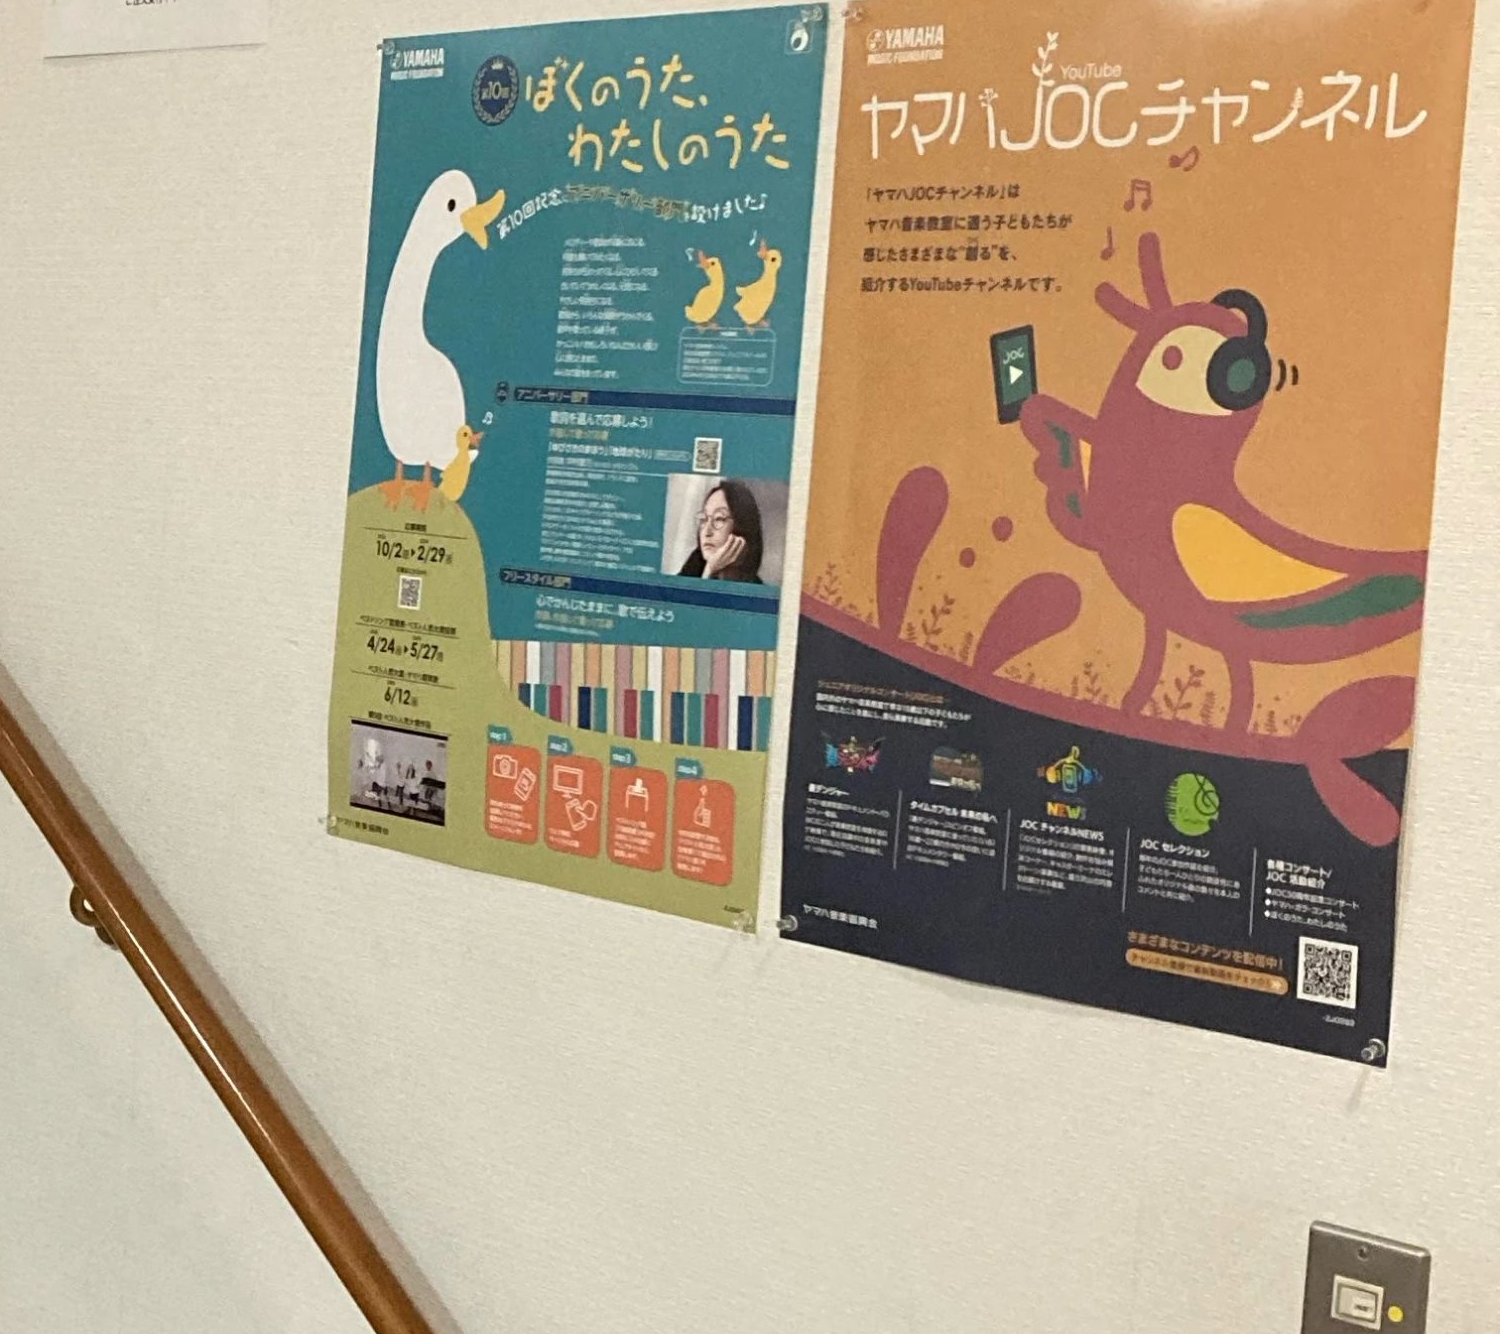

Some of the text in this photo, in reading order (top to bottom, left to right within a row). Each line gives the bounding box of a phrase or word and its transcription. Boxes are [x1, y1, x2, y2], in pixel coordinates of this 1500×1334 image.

[885, 25, 944, 49] YAMAHA
[403, 48, 444, 68] YAMAHA
[1061, 63, 1122, 80] YouTube
[568, 113, 790, 173] わたしのうた
[867, 184, 1020, 202] 「ヤマハJOCチャンネル」は
[866, 214, 1073, 233] ヤマハ音楽教室に通う子どもたちが
[861, 277, 1062, 292] 紹介するYouTubeチャンネルです。
[1020, 819, 1039, 830] JOC
[1140, 839, 1211, 859] JOC セレクション
[1266, 871, 1287, 883] JOC
